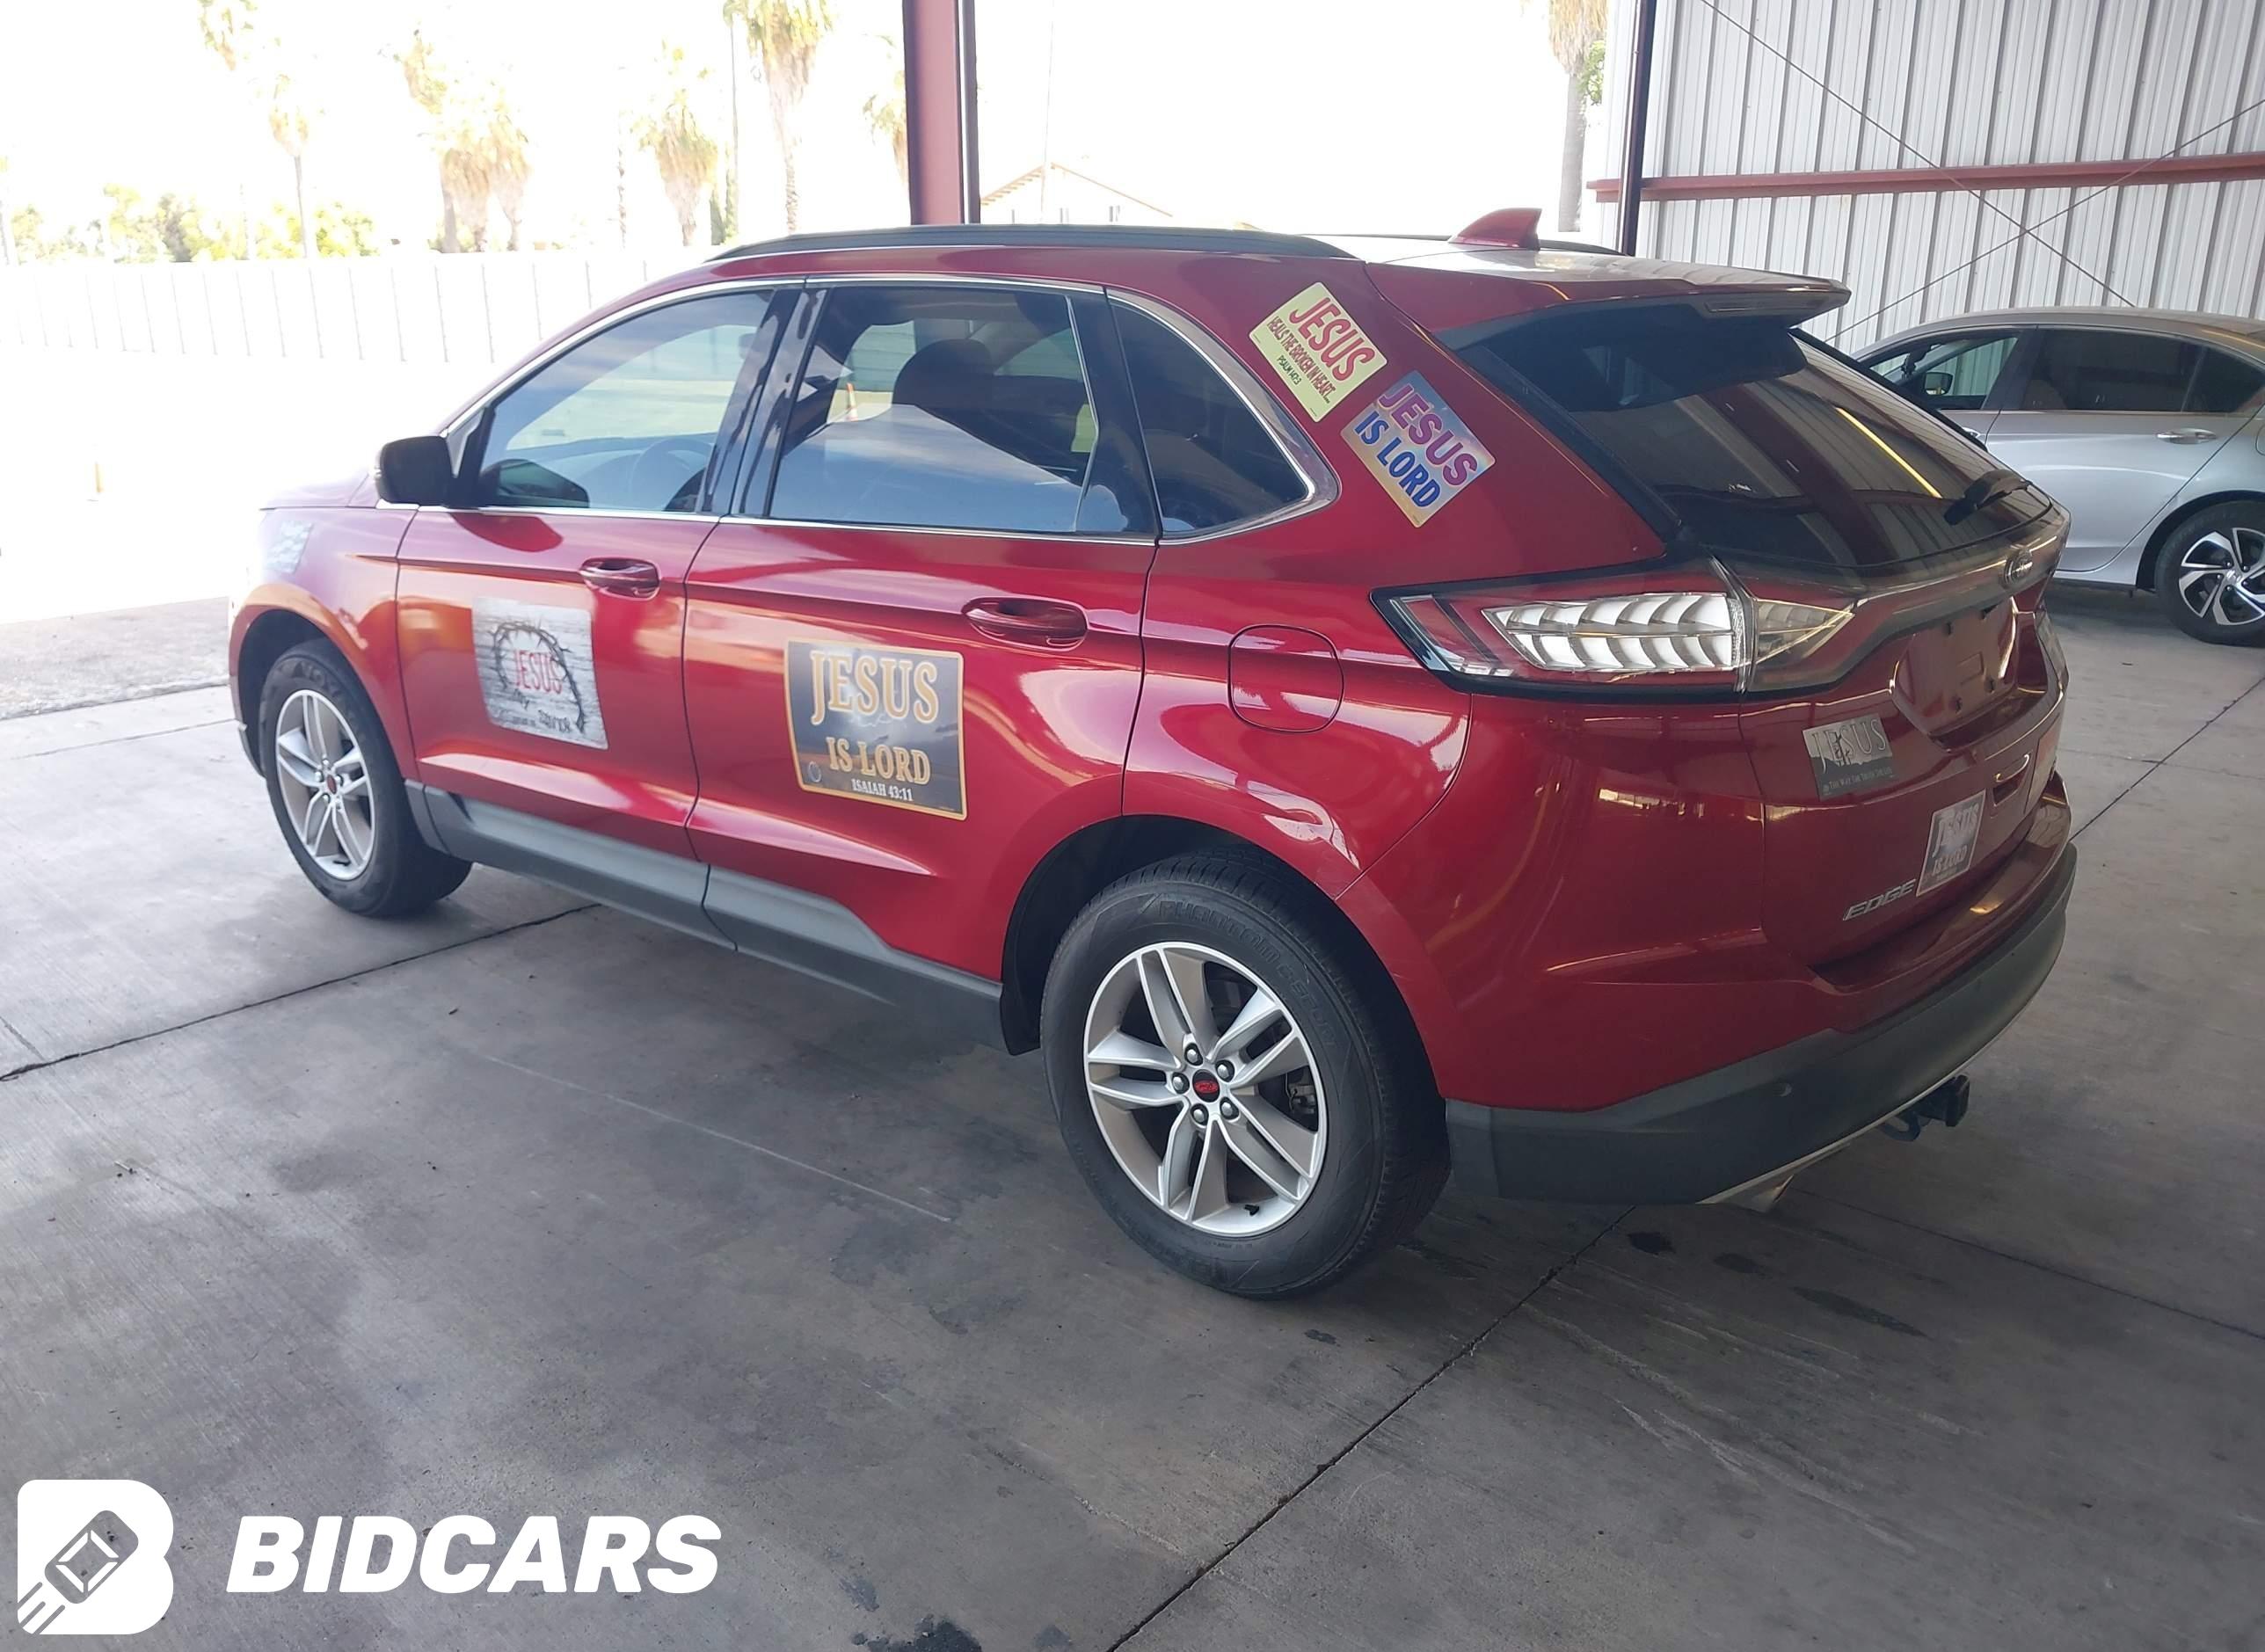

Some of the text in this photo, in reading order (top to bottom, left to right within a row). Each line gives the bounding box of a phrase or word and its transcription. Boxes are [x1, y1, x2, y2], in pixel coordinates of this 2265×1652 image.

[1265, 316, 1290, 340] HEALS
[1279, 333, 1299, 352] THE
[1289, 297, 1375, 381] JESUS
[1276, 354, 1302, 385] PSALM 147:3
[1288, 344, 1316, 374] BROKEN
[1305, 365, 1321, 380] IN
[1377, 383, 1478, 486] JESUS
[1354, 411, 1441, 508] IS LORD
[514, 650, 563, 694] JESUS
[810, 650, 939, 725] JESUS
[826, 736, 931, 785] IS LORD
[1812, 718, 1887, 773] JESUS
[851, 778, 914, 802] ISAIAH 43:11
[1843, 878, 1917, 921] EDGE
